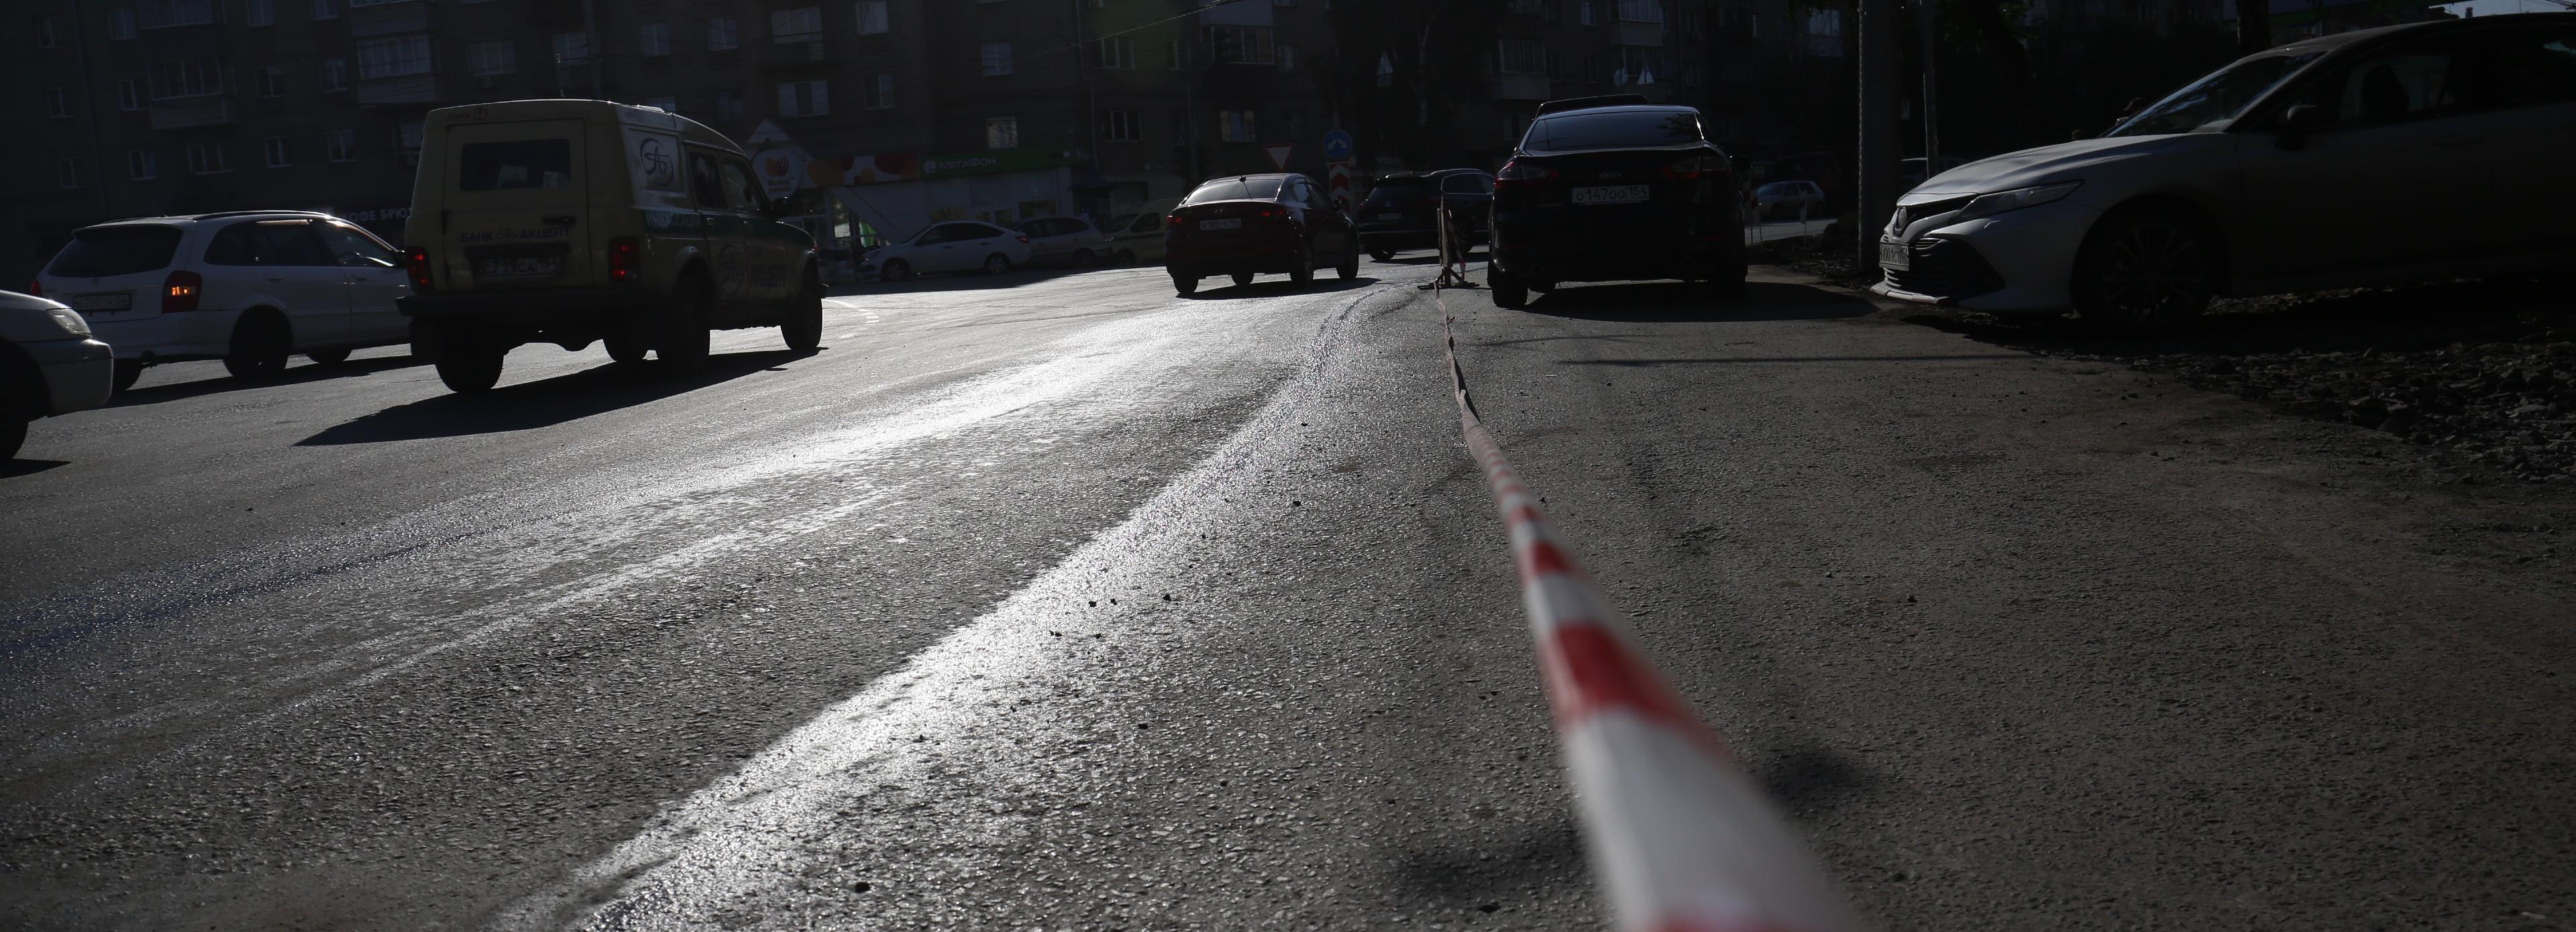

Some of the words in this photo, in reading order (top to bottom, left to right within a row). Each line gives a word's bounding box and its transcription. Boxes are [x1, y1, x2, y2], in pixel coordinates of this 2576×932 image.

[939, 158, 998, 171] МЕГАФОН
[1627, 186, 1647, 196] 154
[461, 231, 494, 243] БАНК
[519, 225, 570, 240] АКЦЕПТ
